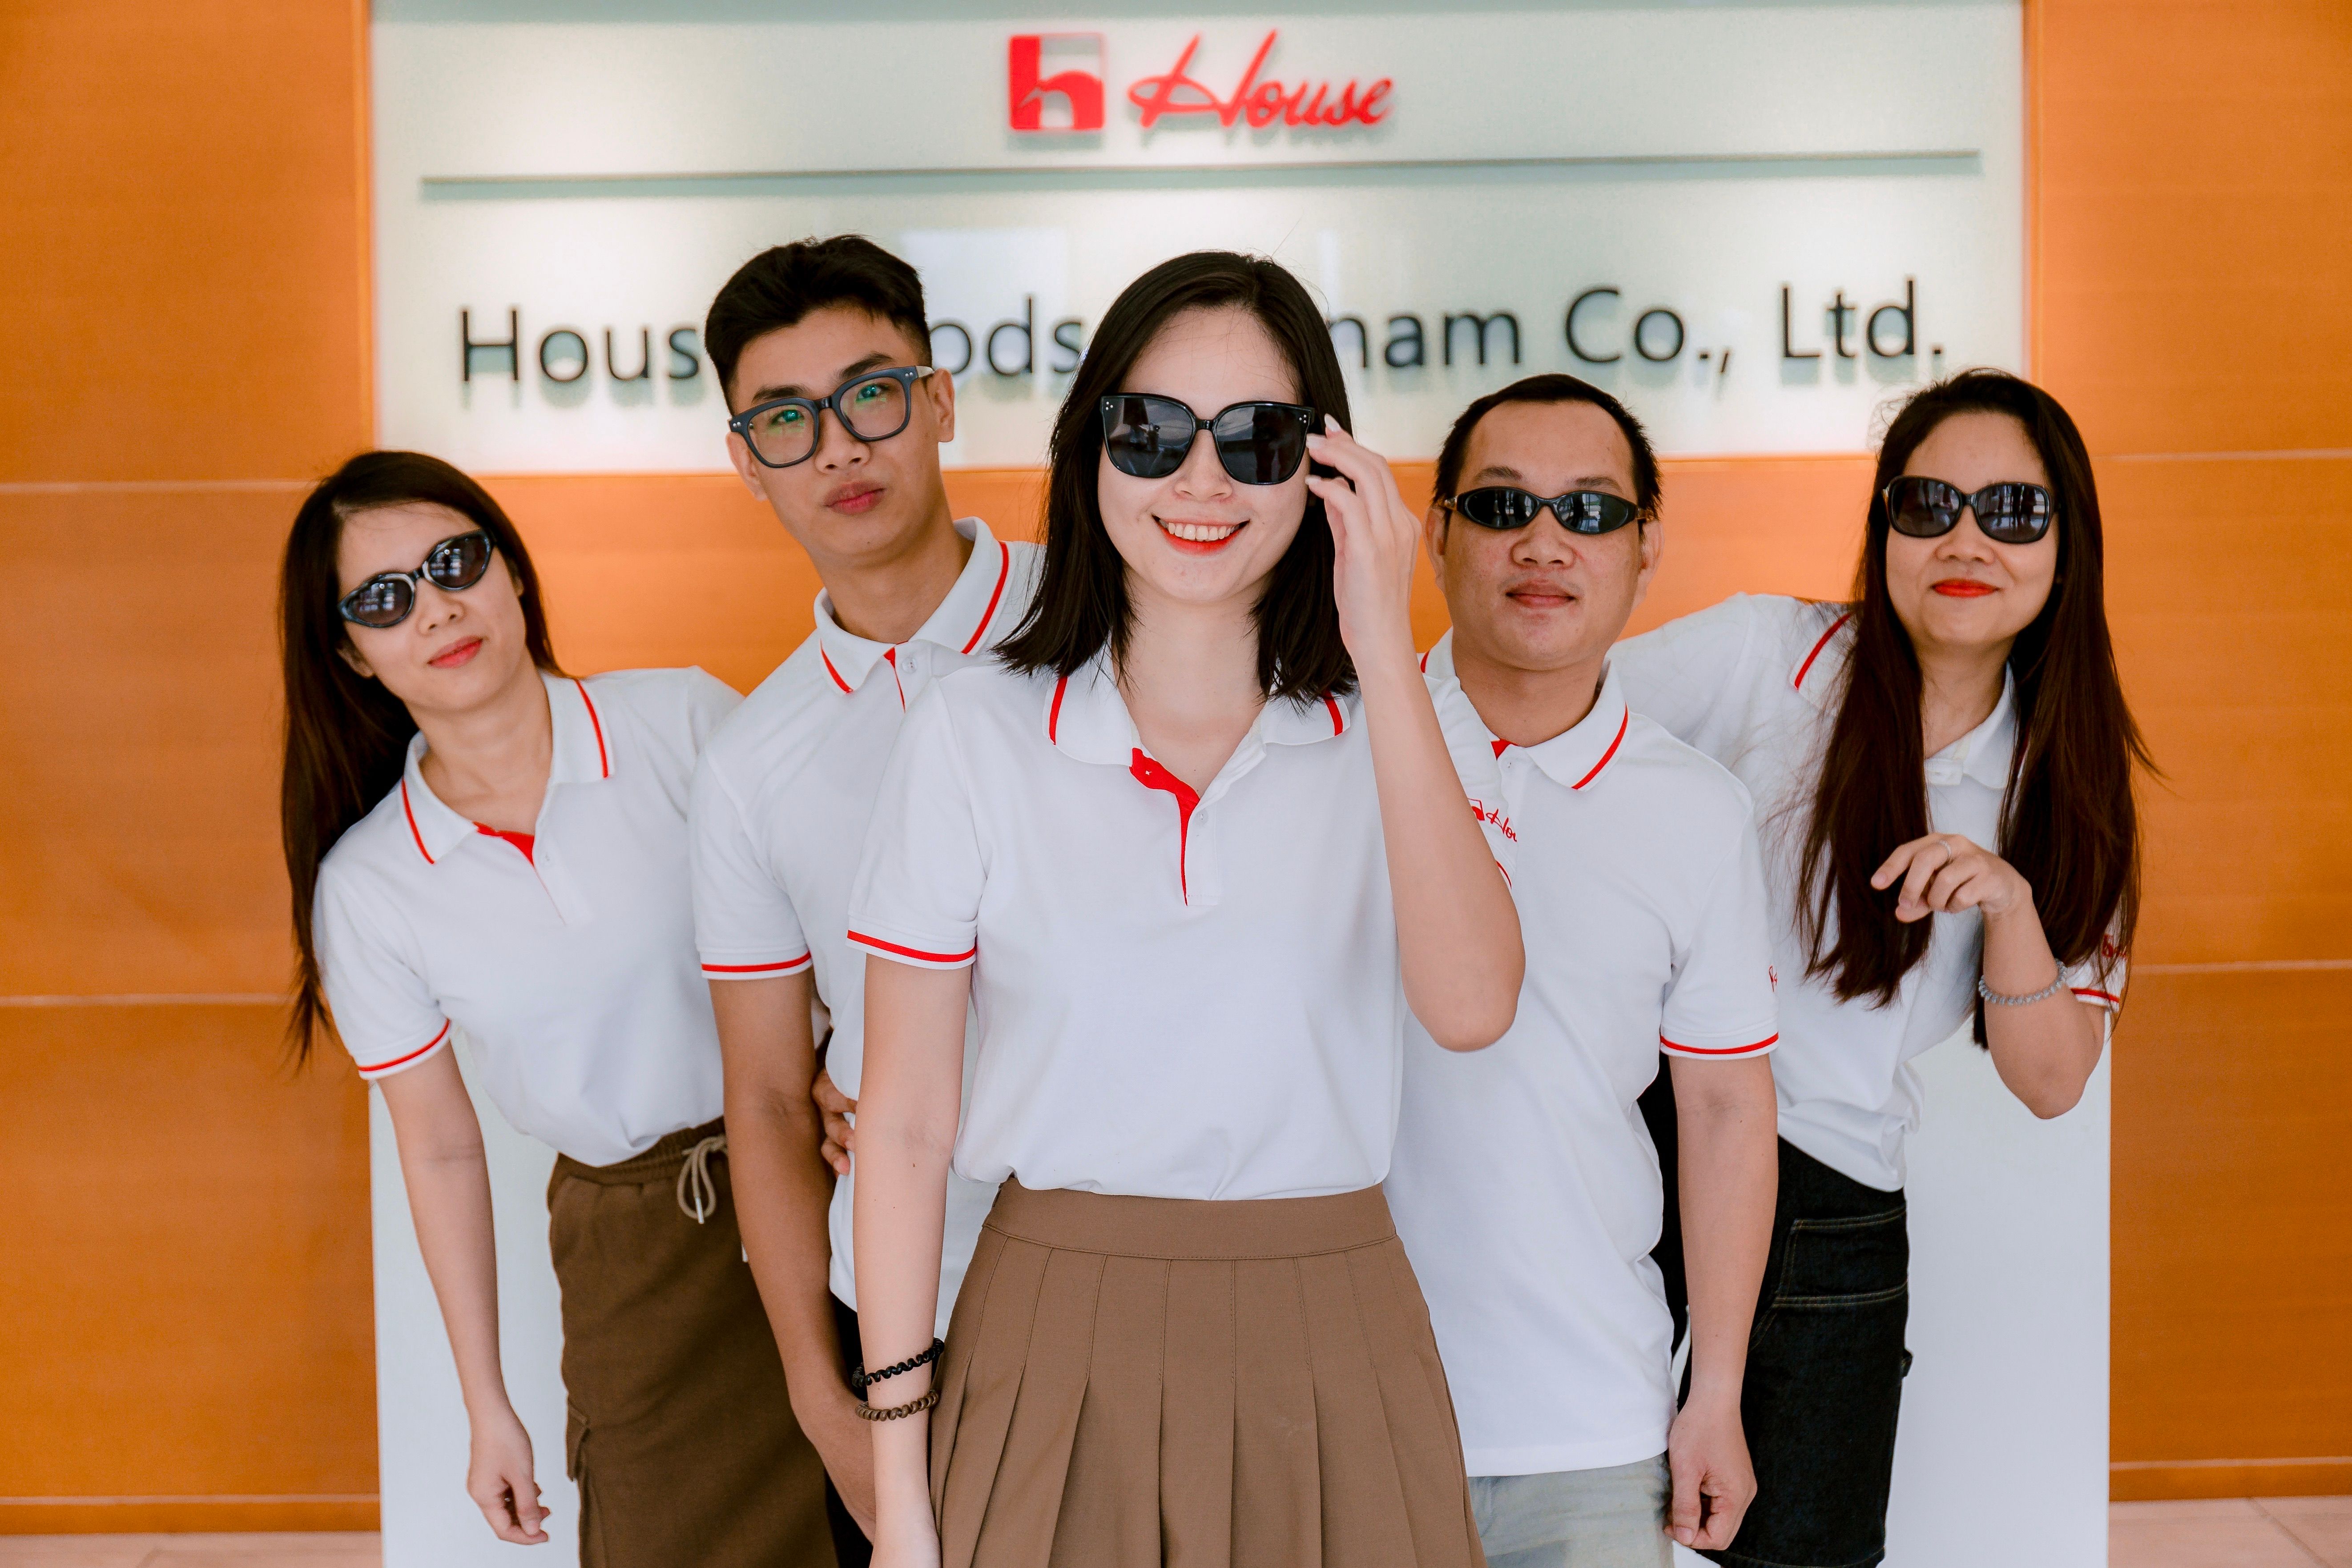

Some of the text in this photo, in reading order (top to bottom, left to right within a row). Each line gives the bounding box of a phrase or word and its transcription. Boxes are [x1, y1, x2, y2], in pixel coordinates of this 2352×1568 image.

[1127, 29, 1394, 128] House
[462, 307, 700, 383] Hous
[930, 295, 1083, 376] ods
[1565, 287, 1729, 374] Co.,
[1782, 278, 1943, 359] Ltd.
